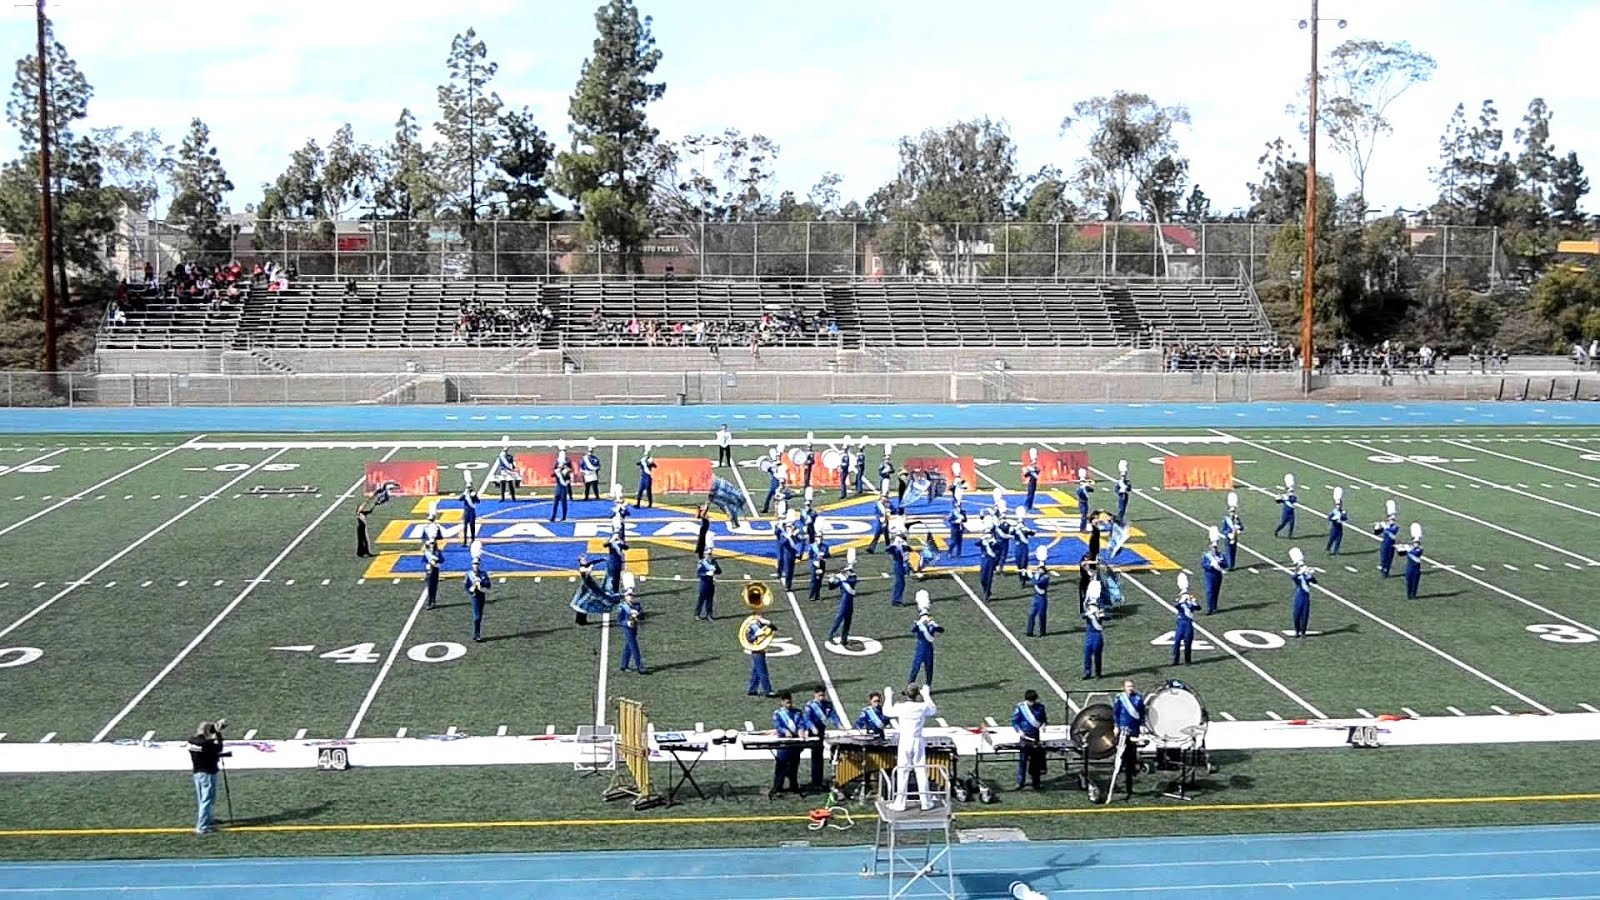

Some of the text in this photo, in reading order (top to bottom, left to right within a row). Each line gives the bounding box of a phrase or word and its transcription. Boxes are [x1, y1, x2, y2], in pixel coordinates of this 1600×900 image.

[1150, 629, 1286, 649] 40
[319, 642, 468, 663] 40
[1352, 726, 1378, 747] 40
[319, 749, 347, 770] 40
